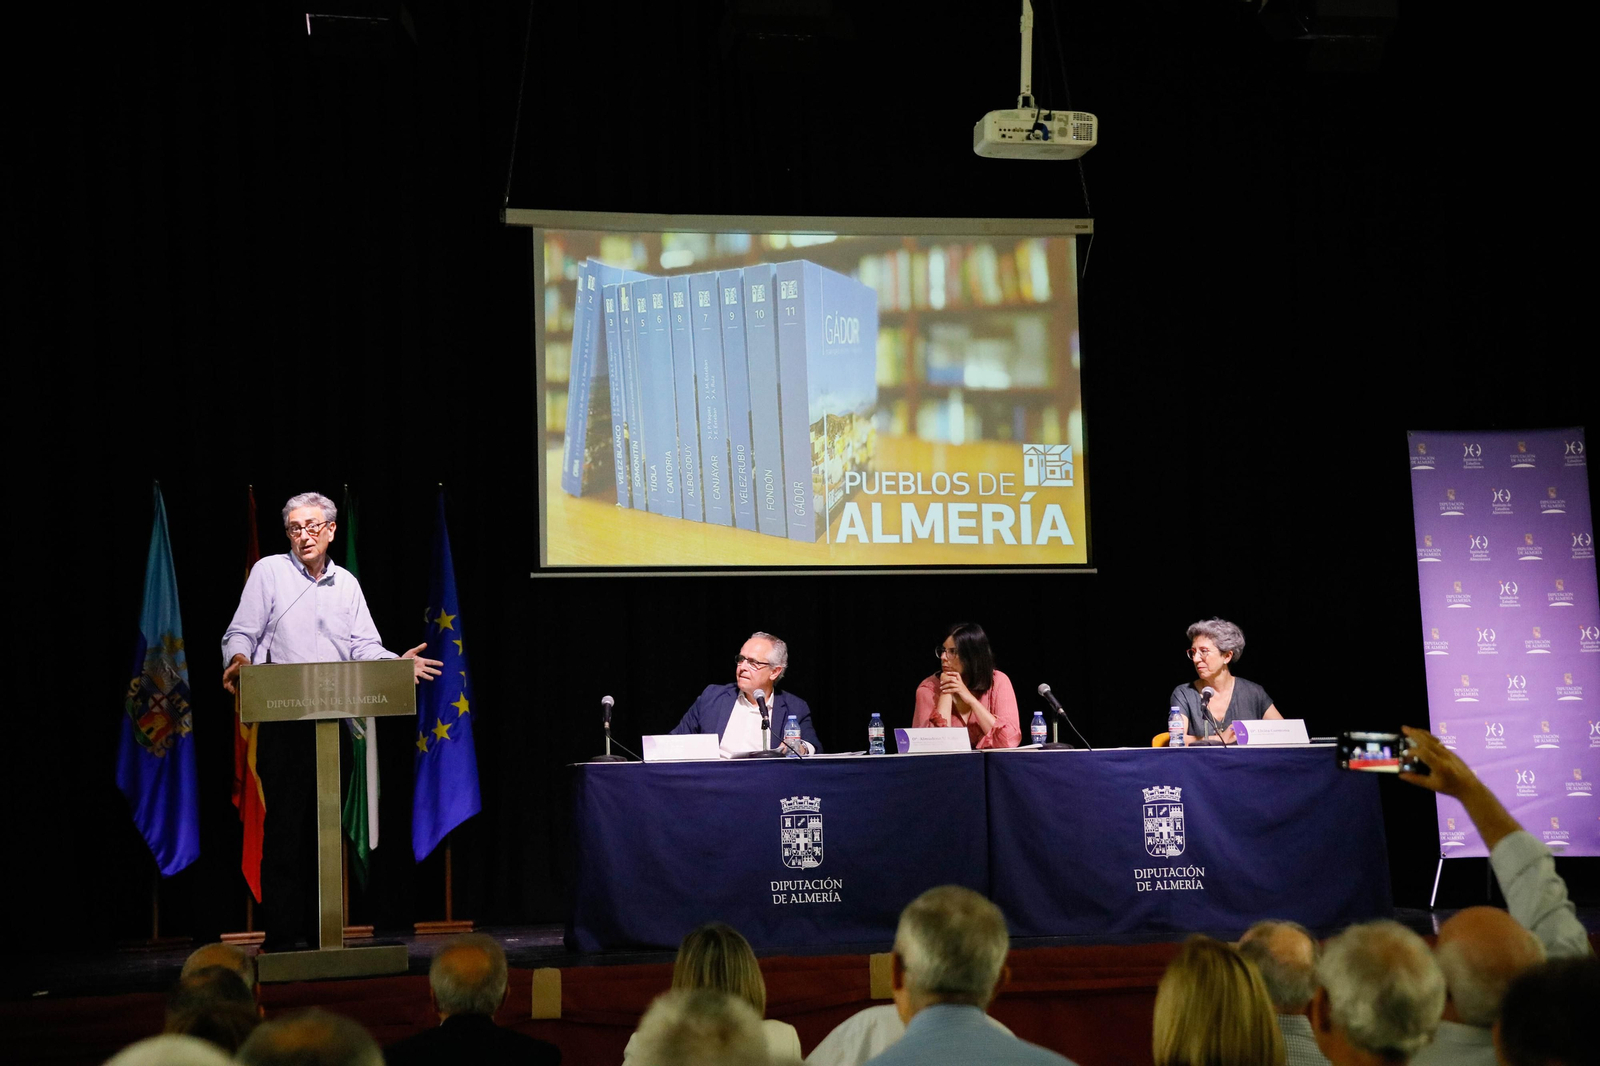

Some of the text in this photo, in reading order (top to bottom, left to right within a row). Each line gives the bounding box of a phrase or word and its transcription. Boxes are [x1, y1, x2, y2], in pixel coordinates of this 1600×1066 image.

[703, 314, 708, 322] 7
[729, 312, 735, 321] 9
[755, 309, 765, 319] 10
[785, 306, 795, 316] 11
[608, 318, 614, 327] 3
[624, 317, 629, 325] 4
[640, 319, 645, 327] 5
[657, 315, 662, 324] 6
[677, 314, 682, 323] 8
[825, 310, 860, 344] GÁDOR
[737, 444, 746, 474] RUBIO
[665, 450, 674, 494] CANTORIA
[684, 443, 695, 498] ALBOLODUY
[710, 455, 721, 500] CANJÁYAR
[764, 469, 775, 511] FONDÓN
[845, 472, 1015, 496] PUEBLOS DE
[792, 481, 805, 516] GÁDOR
[836, 492, 1074, 545] ALMERÍA
[267, 697, 328, 708] DIPUTACIÓN
[346, 694, 388, 705] ALMERÍA
[1134, 865, 1204, 879] DIPUTACIÓN
[770, 877, 842, 891] DIPUTACIÓN
[1137, 878, 1204, 892] DE ALMERÍA
[773, 890, 841, 904] DE ALMERÍA
